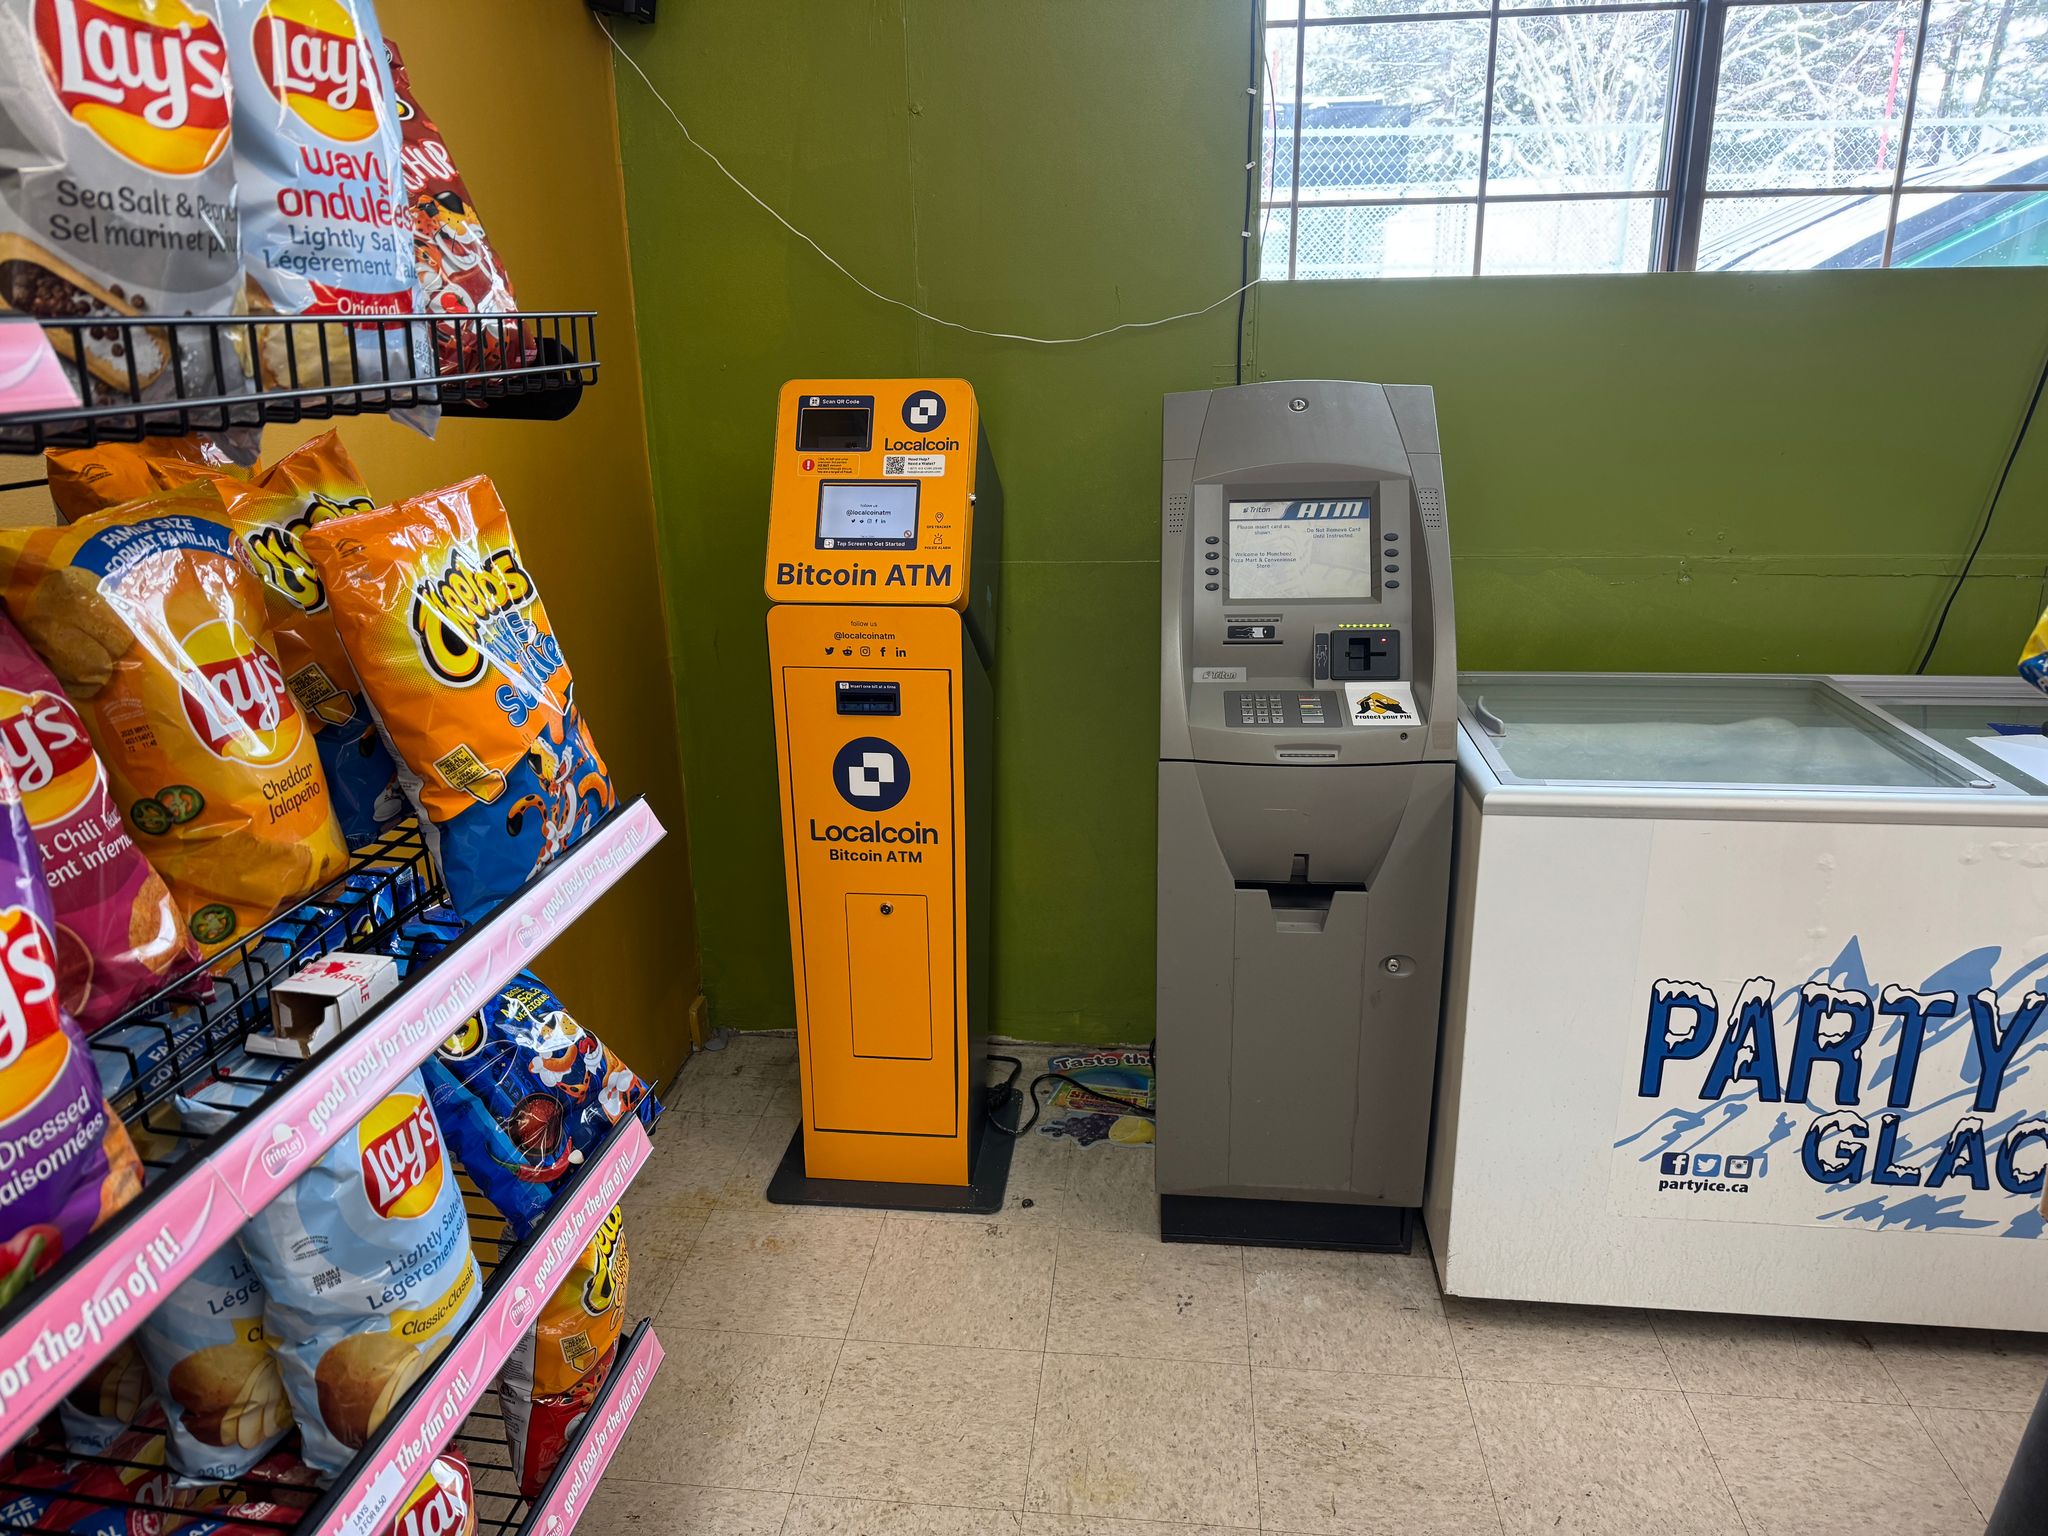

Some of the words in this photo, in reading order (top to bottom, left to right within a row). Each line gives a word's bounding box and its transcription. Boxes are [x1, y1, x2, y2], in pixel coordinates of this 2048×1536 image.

[54, 0, 226, 129] Lay's
[57, 179, 114, 212] Sea
[118, 186, 171, 217] Salt
[176, 192, 194, 218] &
[49, 213, 98, 244] Sel
[105, 223, 182, 250] marin
[186, 230, 203, 249] et
[288, 224, 365, 255] Lightly
[263, 249, 393, 277] Légèrement
[336, 296, 402, 316] Original
[884, 437, 960, 452] Localcoin
[846, 509, 891, 517] @localcoinatm
[1296, 501, 1363, 518] ATM
[101, 523, 155, 550] FAMILY
[157, 517, 197, 531] SIZE
[776, 561, 877, 586] Bitcoin
[884, 563, 952, 587] ATM
[414, 546, 537, 686] Cheetos
[833, 631, 896, 641] @localcoinatm
[261, 763, 314, 801] Cheddar
[269, 781, 321, 825] Jalapeño
[53, 818, 102, 853] Chili
[810, 819, 938, 845] Localcoin
[829, 848, 883, 863] Bitcoin
[886, 850, 923, 864] ATM
[542, 889, 566, 928] good
[561, 872, 583, 904] food
[580, 862, 598, 891] for
[594, 853, 614, 875] the
[607, 844, 628, 871] fun
[621, 831, 636, 854] of
[308, 1079, 348, 1138] good
[342, 1048, 380, 1098] food
[375, 1035, 401, 1070] for
[399, 1019, 428, 1046] the
[421, 1005, 450, 1036] fun
[447, 983, 467, 1017] of
[1637, 976, 2048, 1113] PARTY
[1054, 1055, 1120, 1070] Taste
[365, 1104, 437, 1208] Lay's
[1658, 1179, 1749, 1194] partyice.ca
[533, 1255, 556, 1294] good
[551, 1221, 575, 1262] food
[570, 1206, 587, 1237] for
[583, 1192, 602, 1217] the
[598, 1174, 617, 1208] fun
[613, 1161, 626, 1186] of
[386, 1226, 444, 1277] Lightly
[366, 1234, 458, 1311] Légèrement
[31, 1322, 84, 1372] the
[80, 1286, 131, 1345] fun
[127, 1252, 158, 1299] of
[146, 1225, 183, 1273] it!
[401, 1307, 447, 1337] Classic
[451, 1367, 471, 1401] it!
[443, 1388, 460, 1421] of
[418, 1412, 446, 1455] fun
[562, 1471, 584, 1518] good
[578, 1441, 600, 1484] food
[594, 1426, 609, 1456] for
[605, 1410, 624, 1435] the
[618, 1393, 635, 1422] fun
[631, 1377, 643, 1401] of
[395, 1439, 423, 1473] the
[353, 1504, 370, 1527] LAYS
